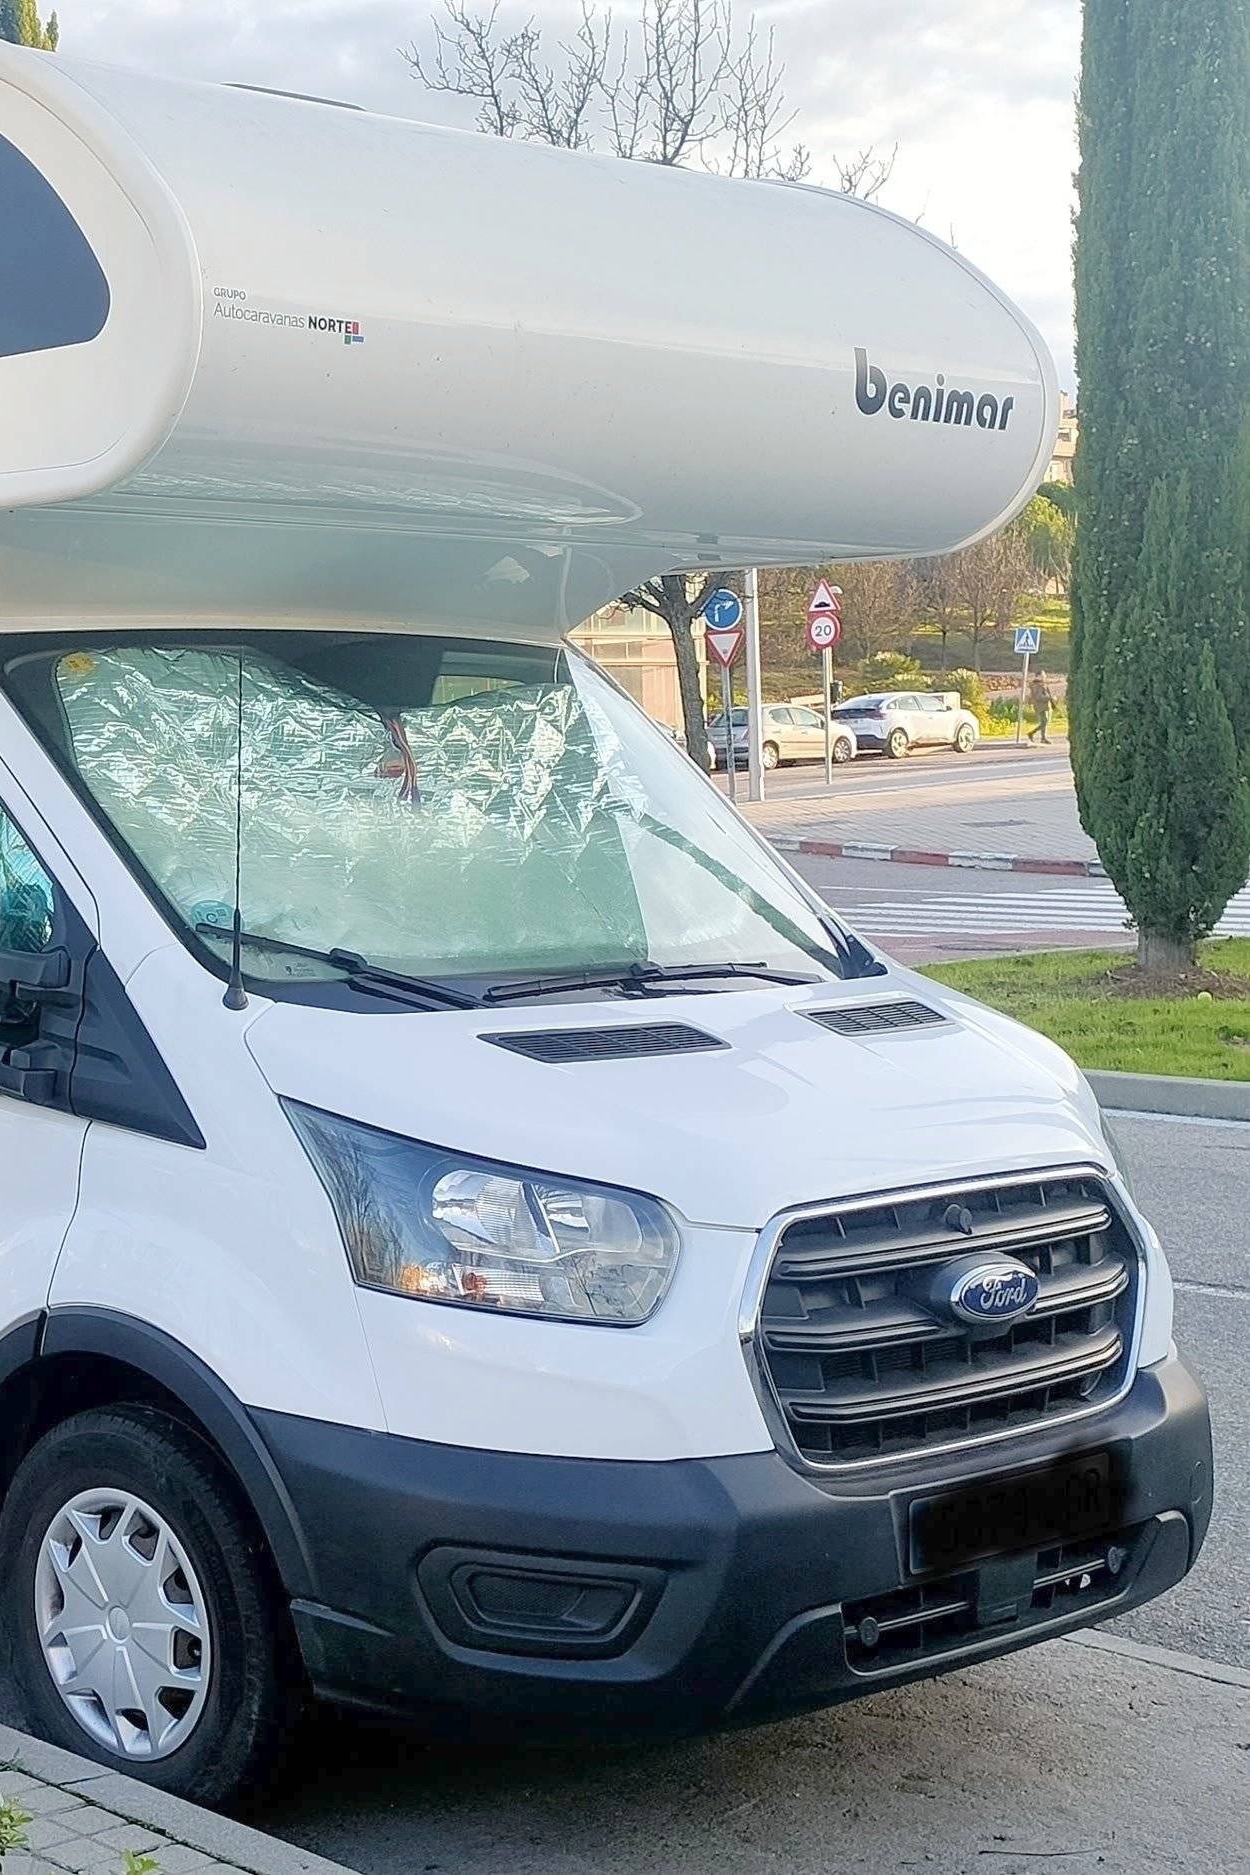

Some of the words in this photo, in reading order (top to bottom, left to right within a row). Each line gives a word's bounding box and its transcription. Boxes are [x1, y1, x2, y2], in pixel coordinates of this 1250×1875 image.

[213, 286, 246, 301] GRUPO
[214, 302, 305, 328] Autocaravanas
[308, 315, 353, 334] NORTE
[854, 346, 1014, 430] benimar
[814, 624, 832, 637] 20
[979, 1272, 1027, 1310] Ford
